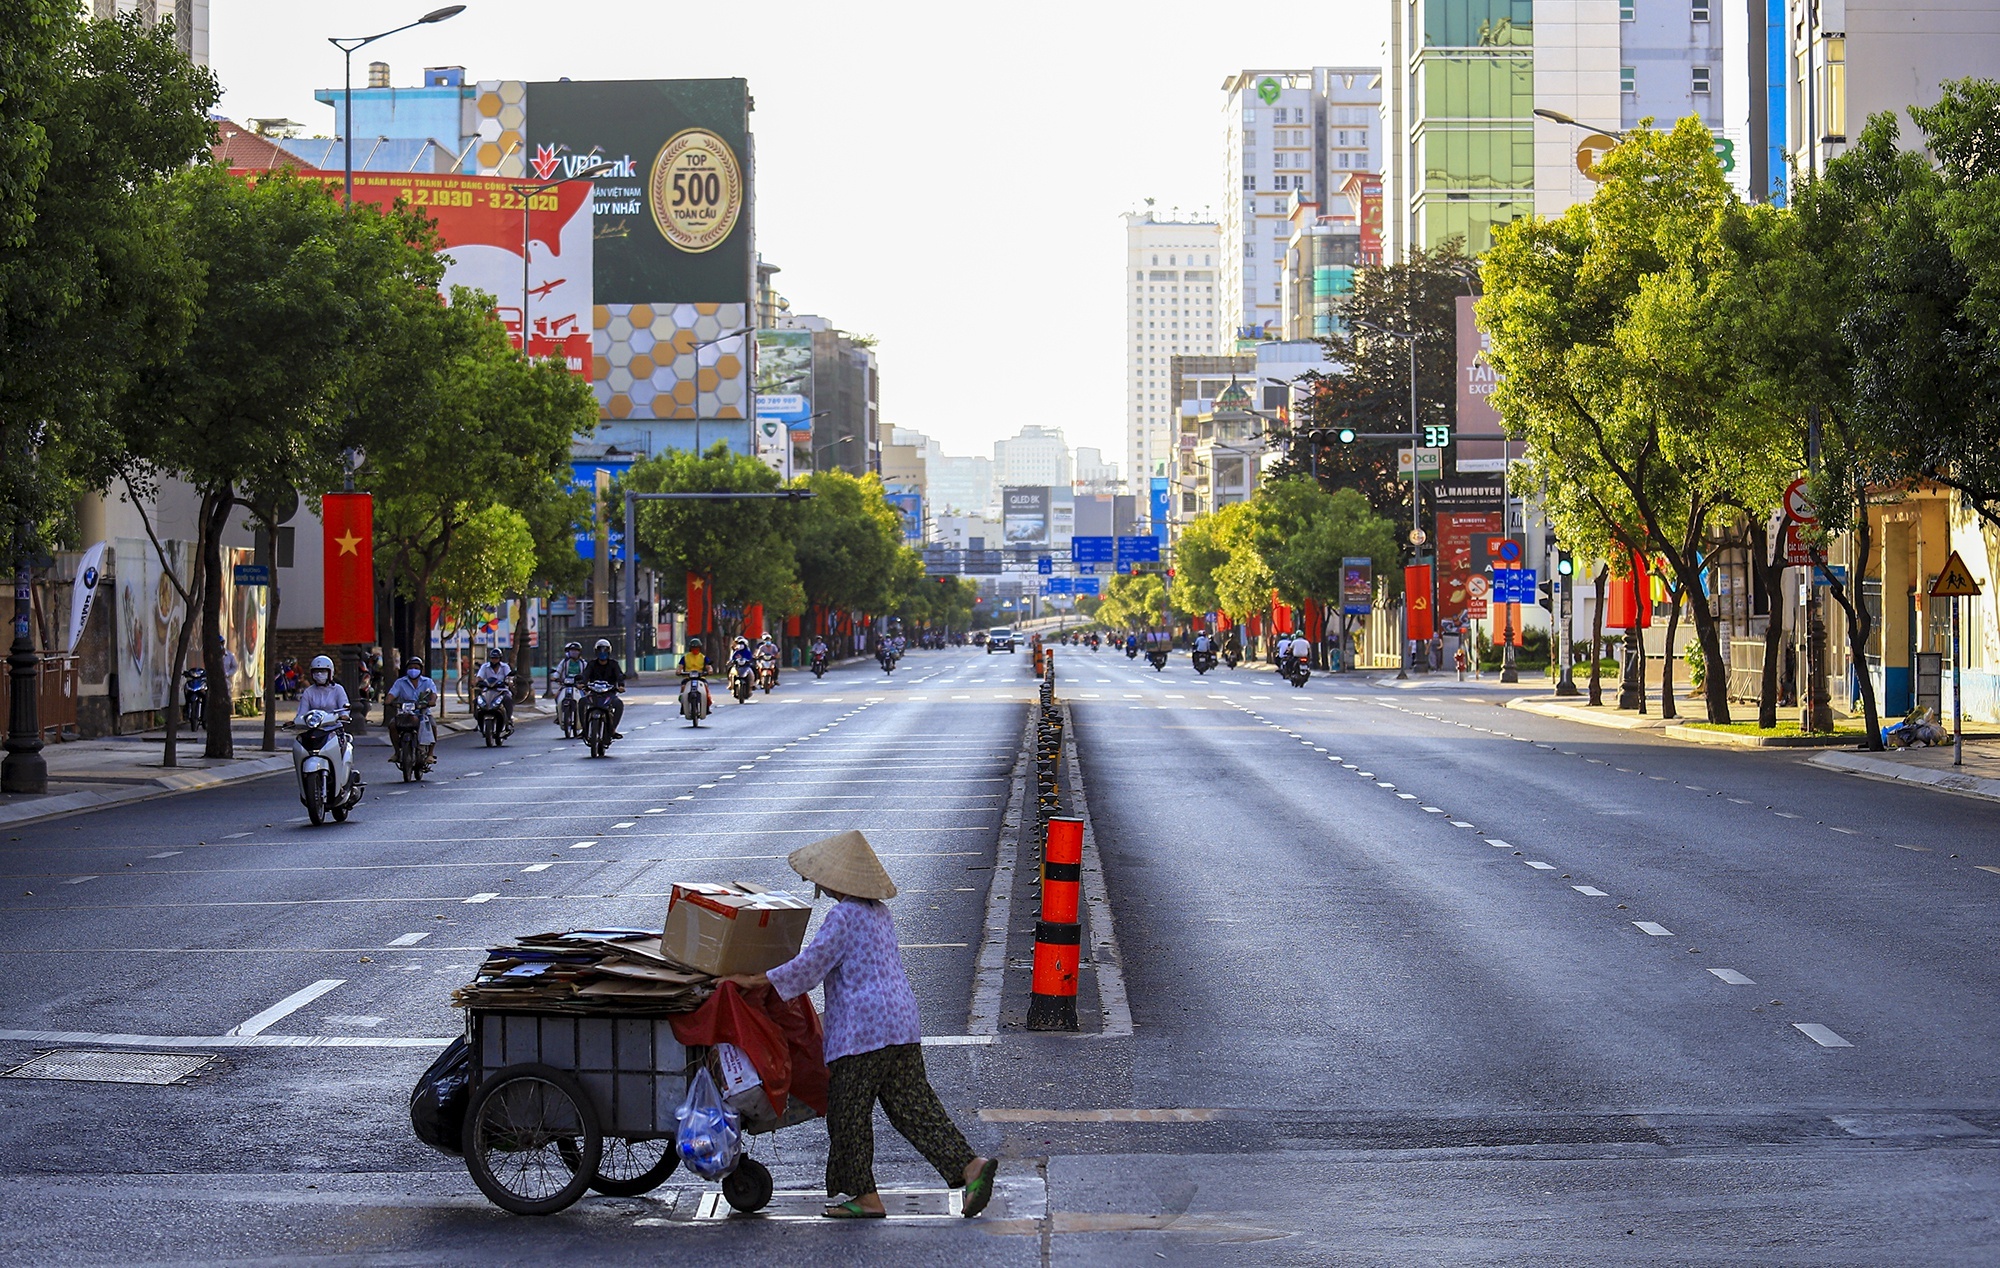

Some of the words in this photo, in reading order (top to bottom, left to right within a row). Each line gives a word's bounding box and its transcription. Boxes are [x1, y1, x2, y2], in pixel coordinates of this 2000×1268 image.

[686, 155, 707, 166] TOP
[353, 178, 366, 186] 90
[415, 178, 442, 188] THÀNH
[672, 173, 720, 206] 500
[607, 186, 622, 199] VIỆT
[623, 187, 641, 197] NAM
[401, 188, 473, 207] 3.2.1930
[489, 192, 559, 212] 3.2.2020
[612, 198, 641, 215] NHẤT
[674, 208, 697, 219] TOÀN
[1425, 427, 1449, 448] 33
[1448, 487, 1502, 496] MAINGUYEN
